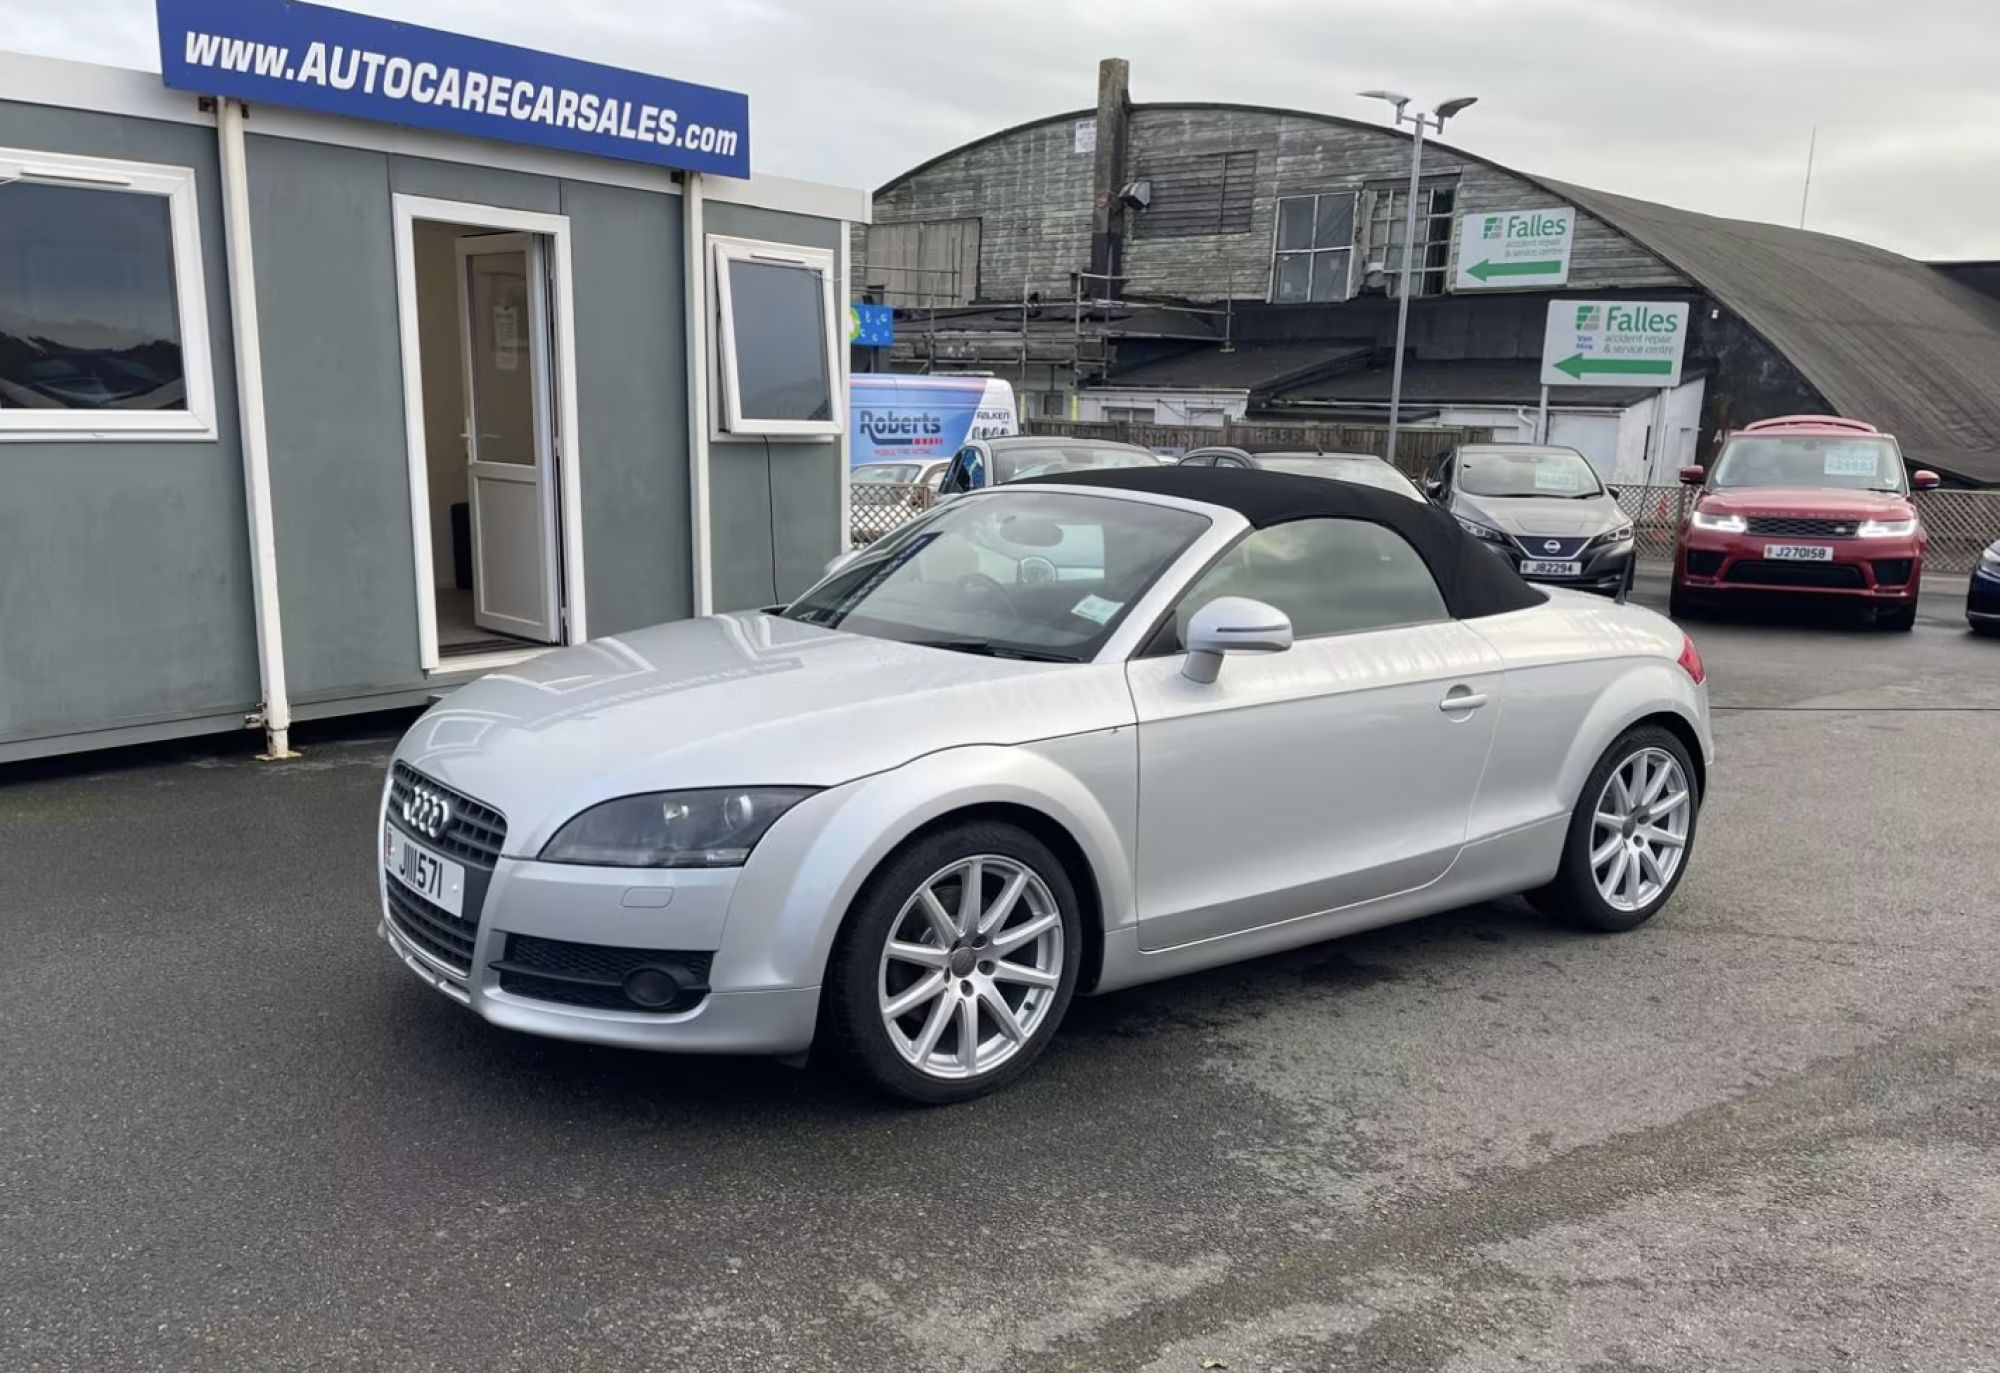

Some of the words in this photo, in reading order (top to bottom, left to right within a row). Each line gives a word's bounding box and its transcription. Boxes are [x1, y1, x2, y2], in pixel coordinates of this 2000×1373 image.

[185, 31, 738, 157] www.AUTOCARECARSALES.com
[1507, 214, 1566, 238] Falles
[1606, 306, 1678, 332] Falles
[1604, 335, 1642, 344] accident
[1645, 335, 1672, 345] repair
[1613, 345, 1643, 353] service
[860, 410, 941, 435] Roberts
[976, 411, 1009, 420] FALKEN
[1776, 546, 1826, 559] J270158
[1532, 563, 1572, 573] J82294
[399, 841, 443, 899] J111571
